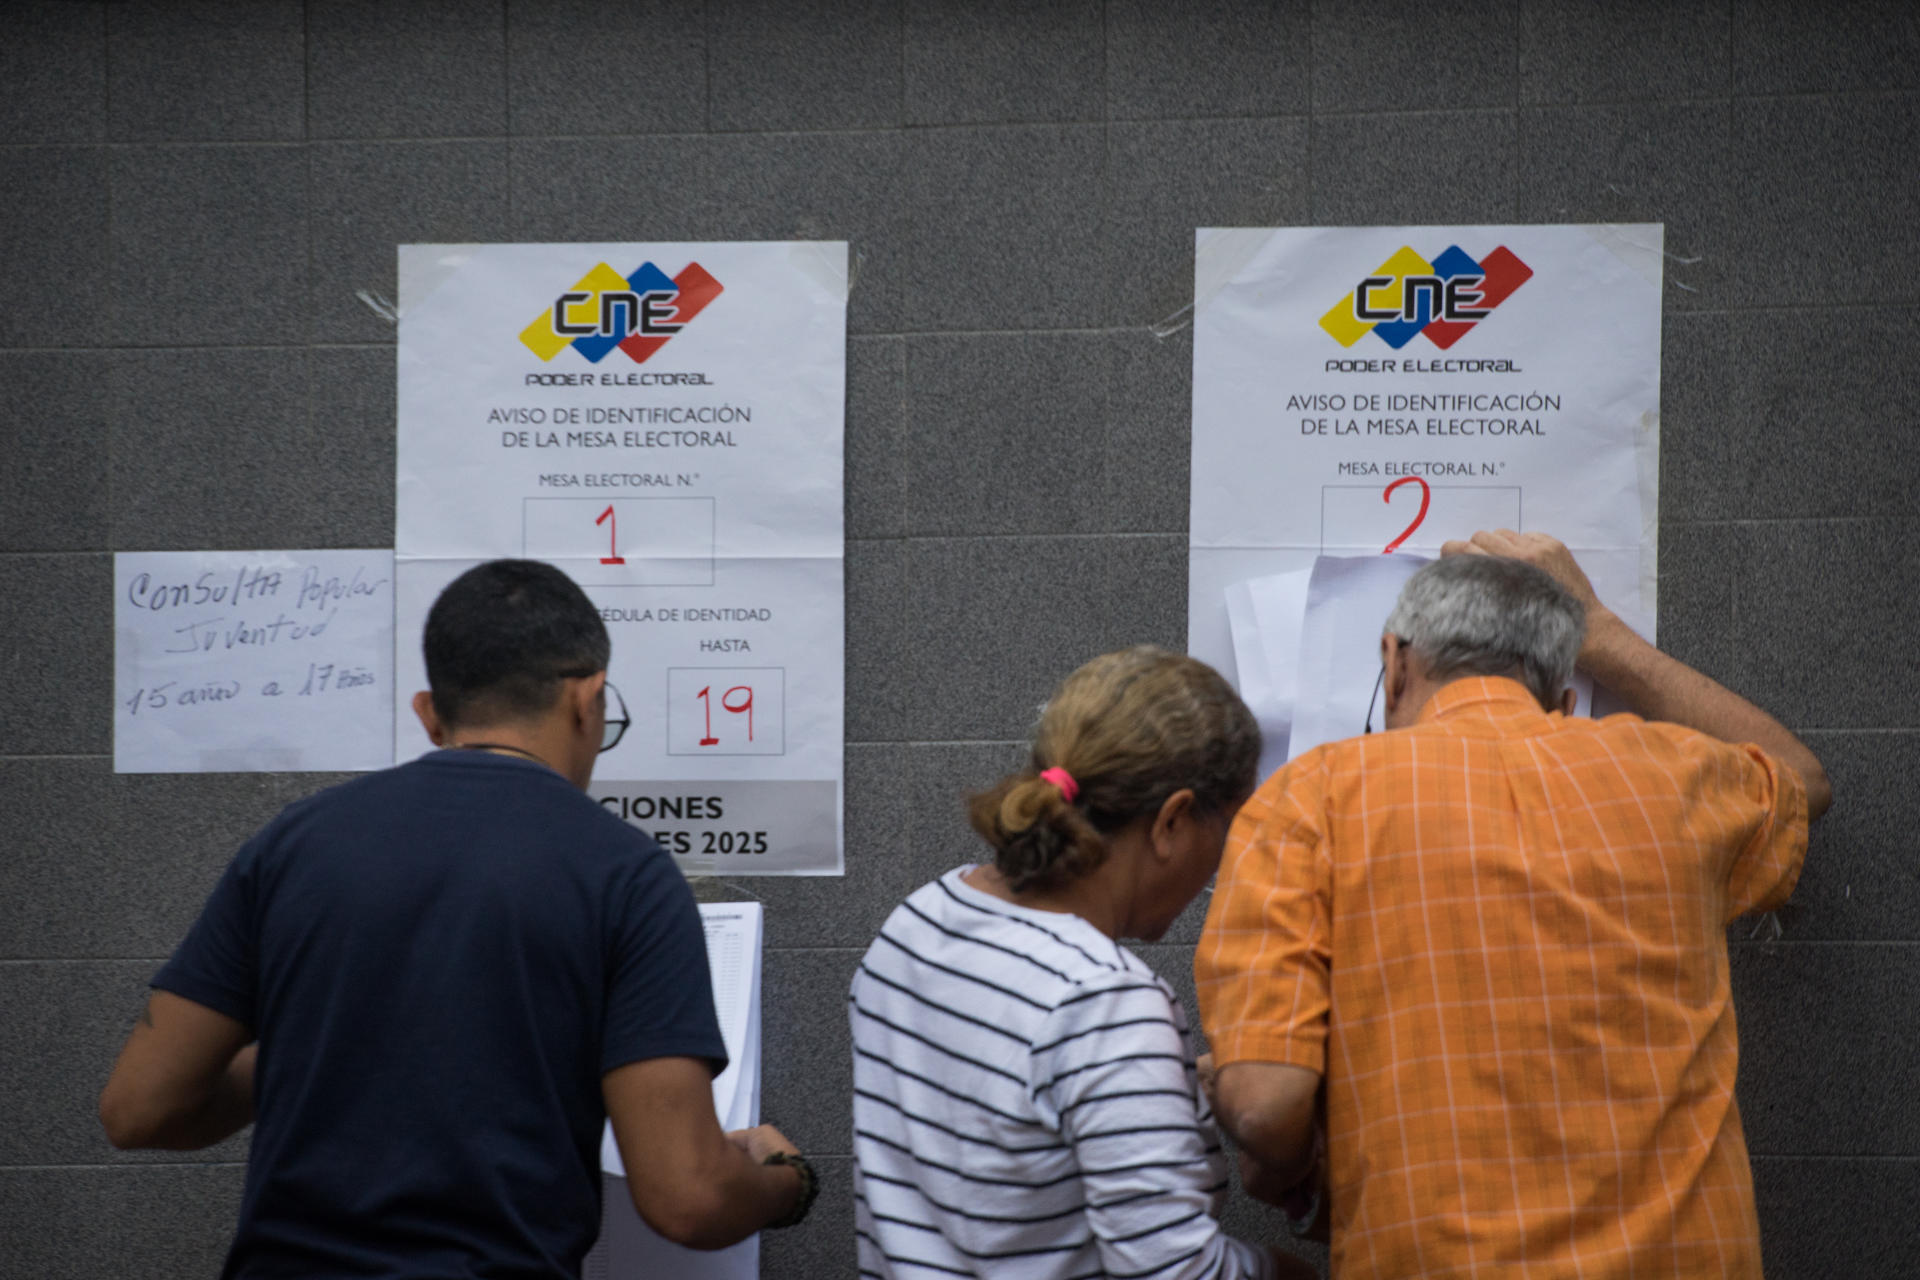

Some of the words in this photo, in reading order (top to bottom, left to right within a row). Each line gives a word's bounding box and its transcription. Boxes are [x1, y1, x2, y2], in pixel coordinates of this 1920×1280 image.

[1325, 359, 1396, 373] PODER
[525, 373, 595, 386] PODER
[1286, 394, 1347, 412] AVISO
[1354, 394, 1380, 412] DE
[1387, 390, 1561, 412] IDENTIFICACIÓN
[487, 407, 546, 424] AVISO
[553, 407, 579, 424] DE
[586, 403, 752, 424] IDENTIFICACIÓN
[1301, 419, 1327, 435] DE
[1335, 419, 1360, 435] LA
[1367, 419, 1419, 435] MESA
[1427, 419, 1546, 436] ELECTORAL
[502, 431, 528, 447] DE
[535, 431, 560, 447] LA
[567, 431, 617, 447] MESA
[624, 431, 736, 447] ELECTORAL
[1338, 462, 1379, 475] MESA
[1385, 462, 1476, 475] ELECTORAL
[539, 474, 579, 486] MESA
[585, 474, 672, 486] ELECTORAL
[1383, 475, 1431, 554] 2
[595, 504, 625, 564] 1
[598, 607, 653, 622] ÉDULA
[658, 608, 679, 622] DE
[684, 608, 772, 622] IDENTIDAD
[700, 639, 751, 652] HASTA
[126, 681, 177, 716] 15
[298, 663, 335, 696] 17
[696, 685, 754, 747] 19
[702, 831, 768, 854] 2025
